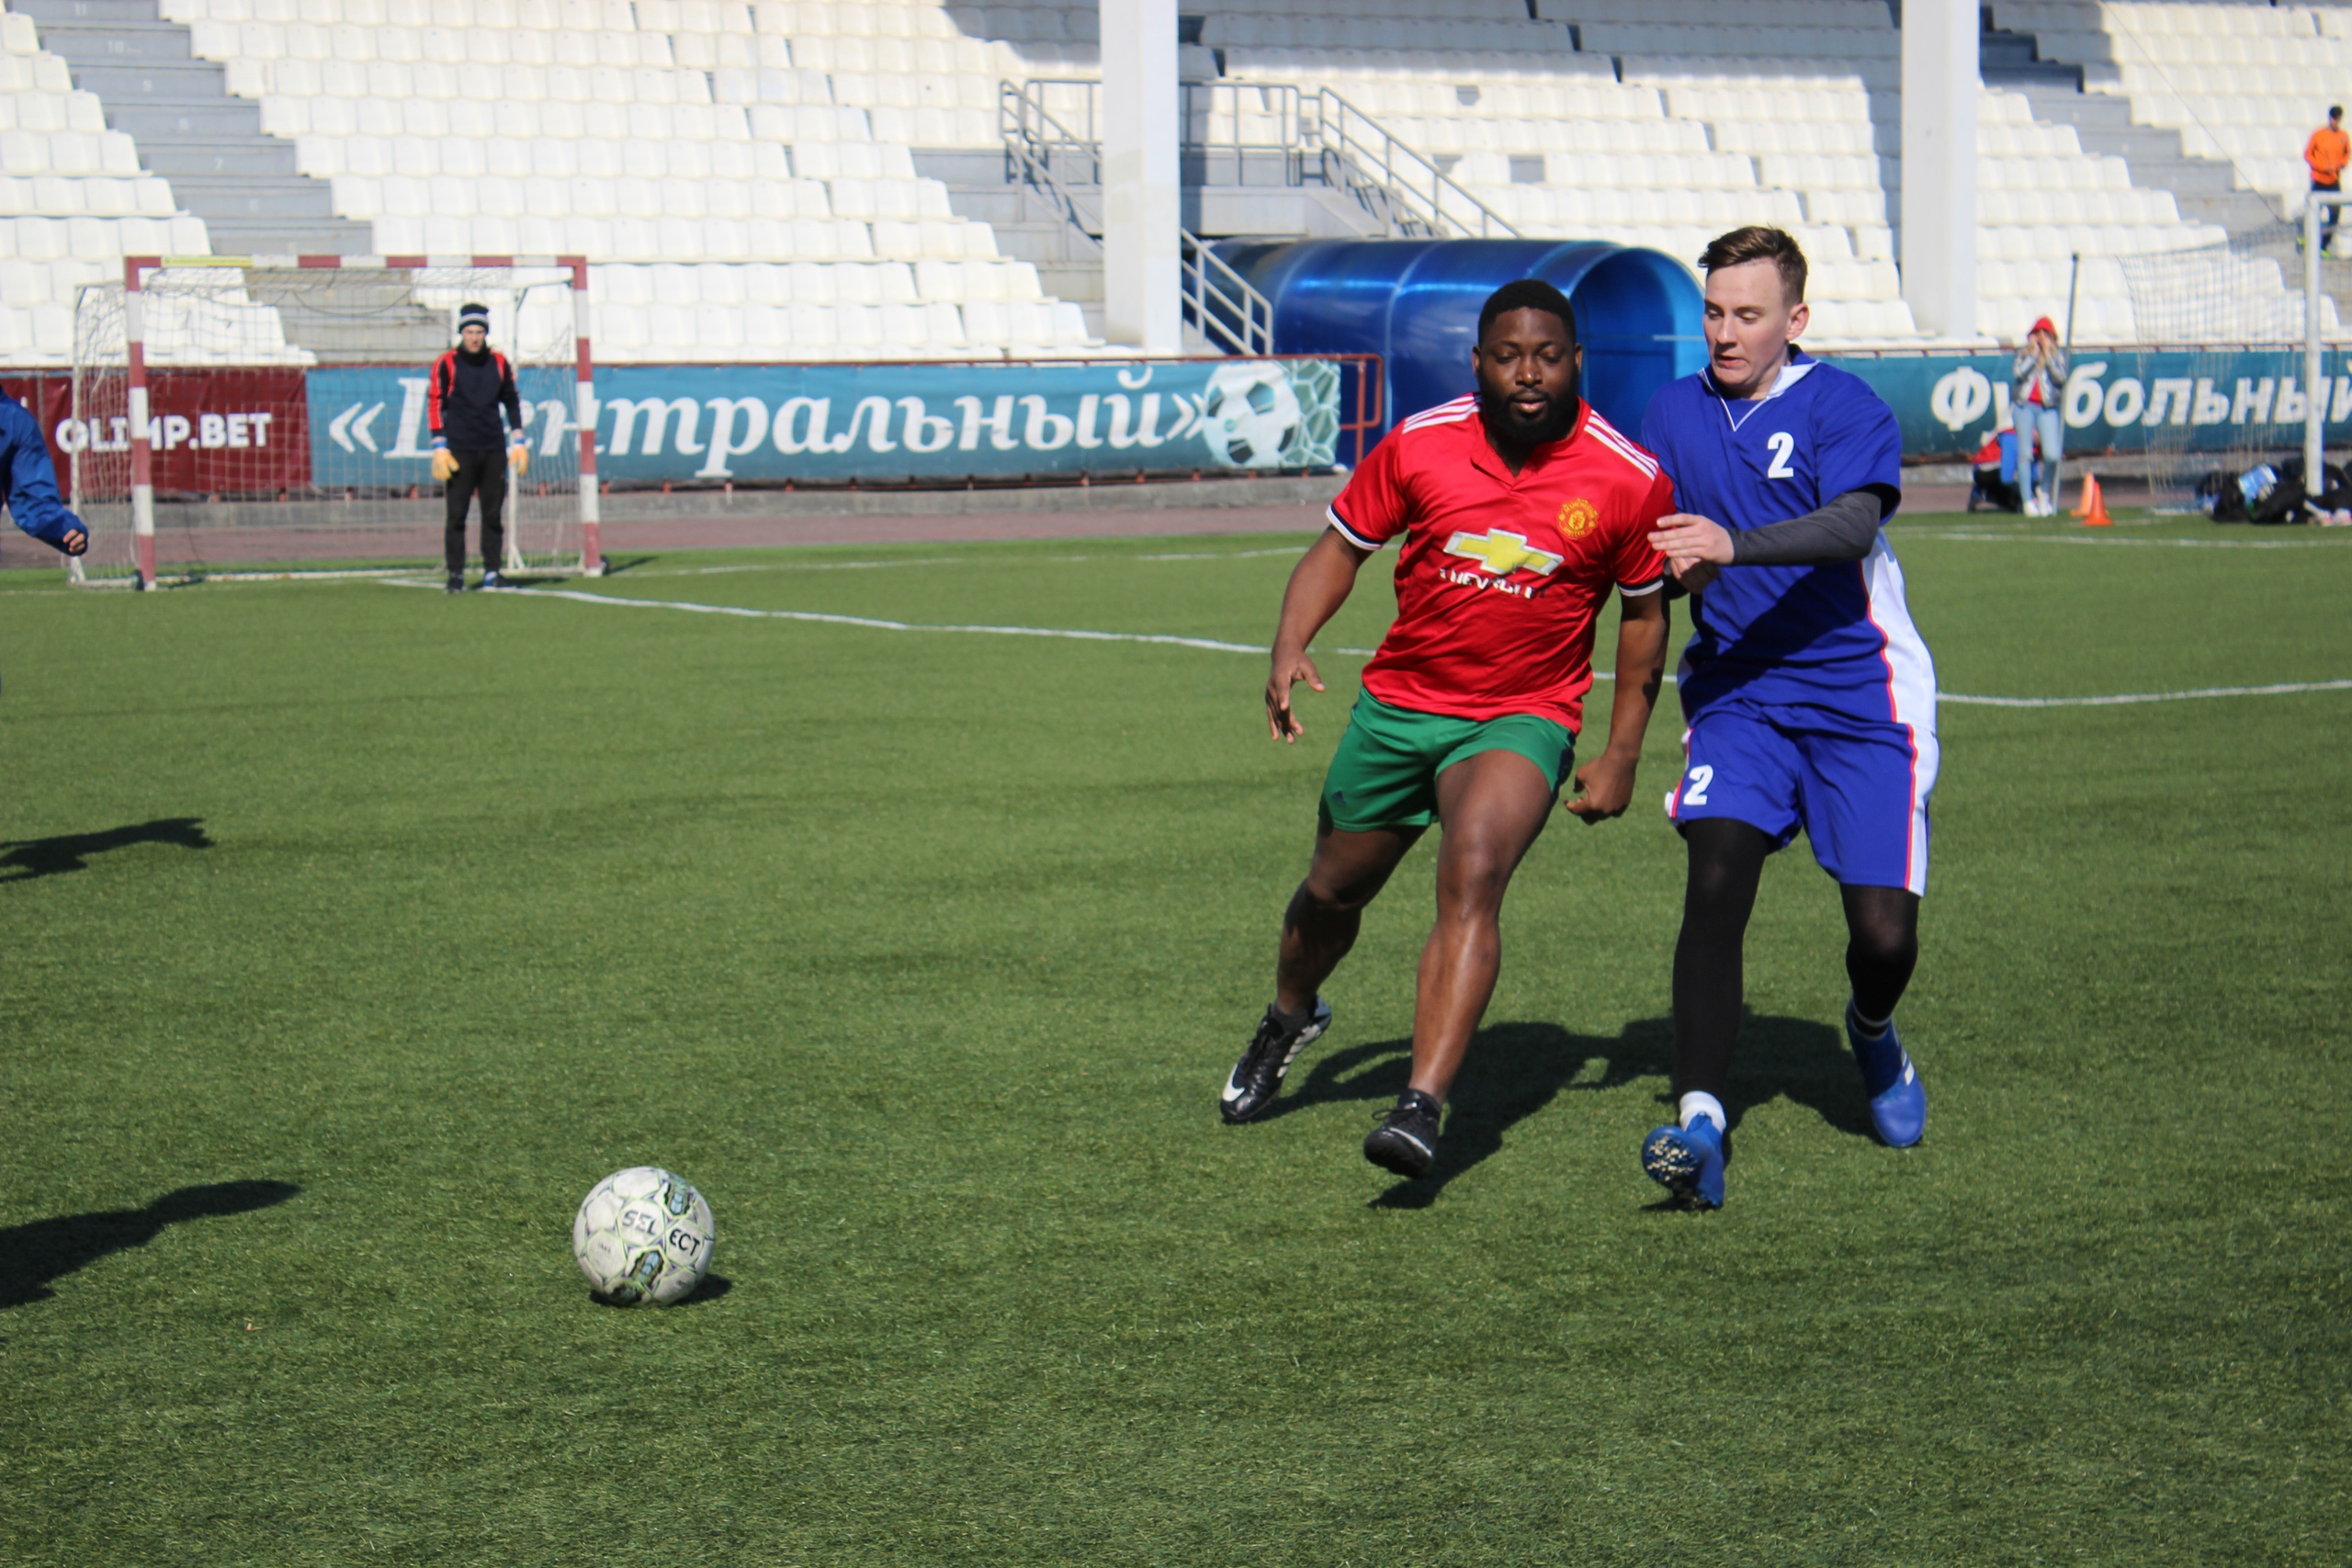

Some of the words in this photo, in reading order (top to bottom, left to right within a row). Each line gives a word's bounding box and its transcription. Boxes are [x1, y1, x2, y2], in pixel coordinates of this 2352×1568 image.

[214, 157, 224, 171] 7
[1931, 358, 2352, 446] Фубольны
[1767, 431, 1795, 479] 2
[1683, 764, 1714, 807] 2
